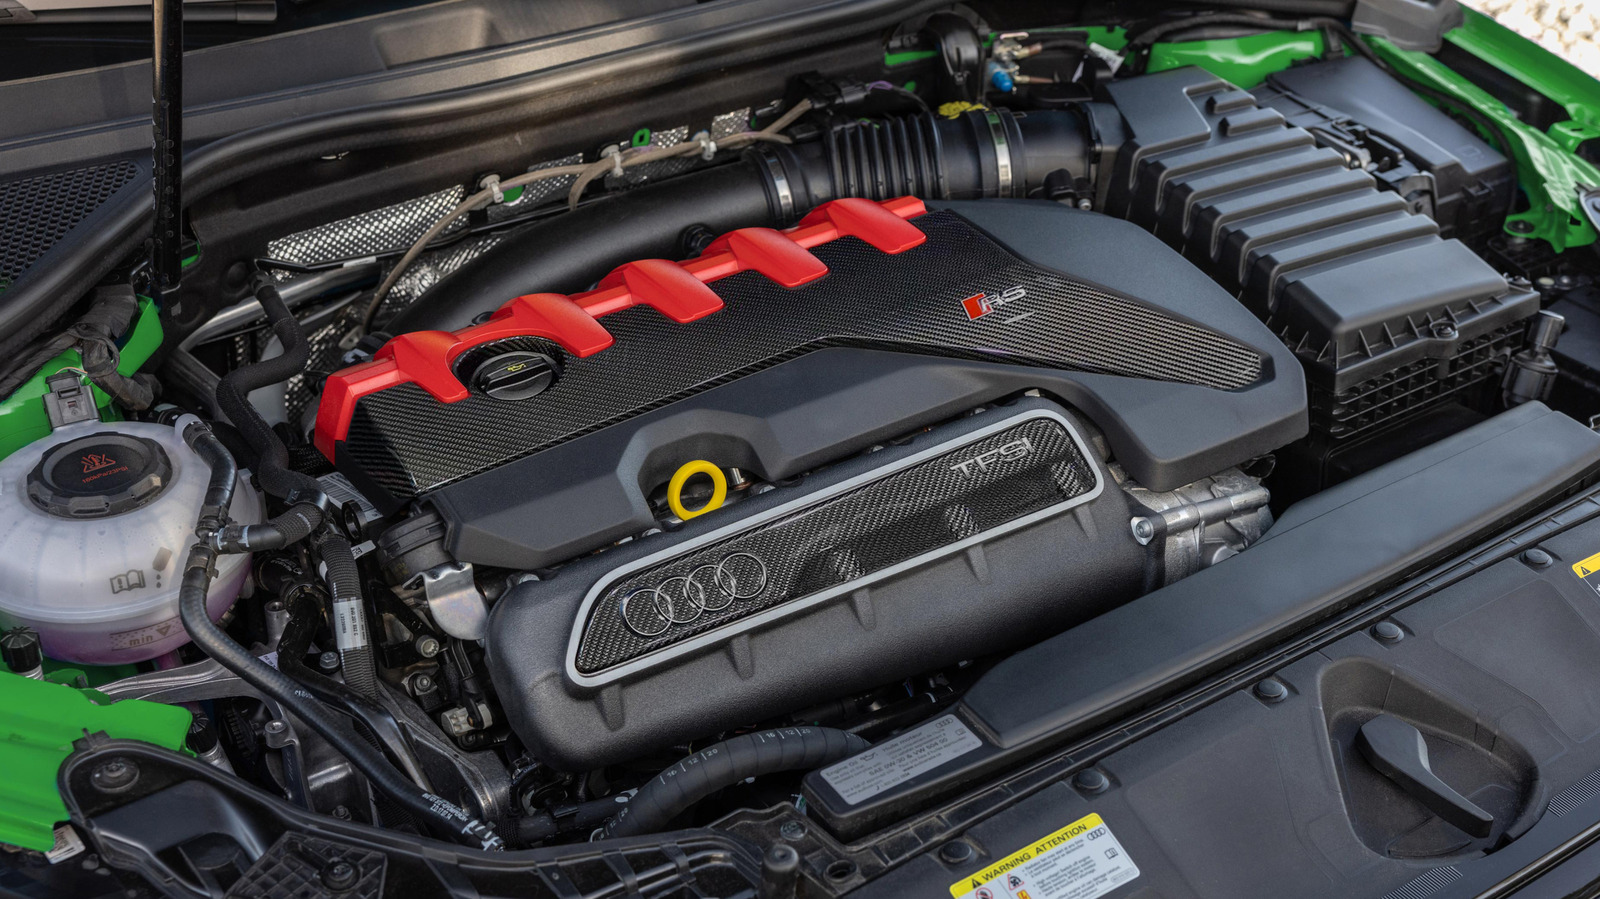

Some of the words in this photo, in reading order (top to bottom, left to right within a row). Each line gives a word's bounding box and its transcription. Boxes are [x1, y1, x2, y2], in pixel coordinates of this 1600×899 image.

[950, 437, 1035, 480] TFSI
[130, 635, 152, 646] min
[688, 757, 699, 765] 12
[706, 748, 718, 757] 20
[912, 746, 926, 755] VW
[982, 853, 1032, 882] WARNING
[1035, 824, 1087, 855] ATTENTION
